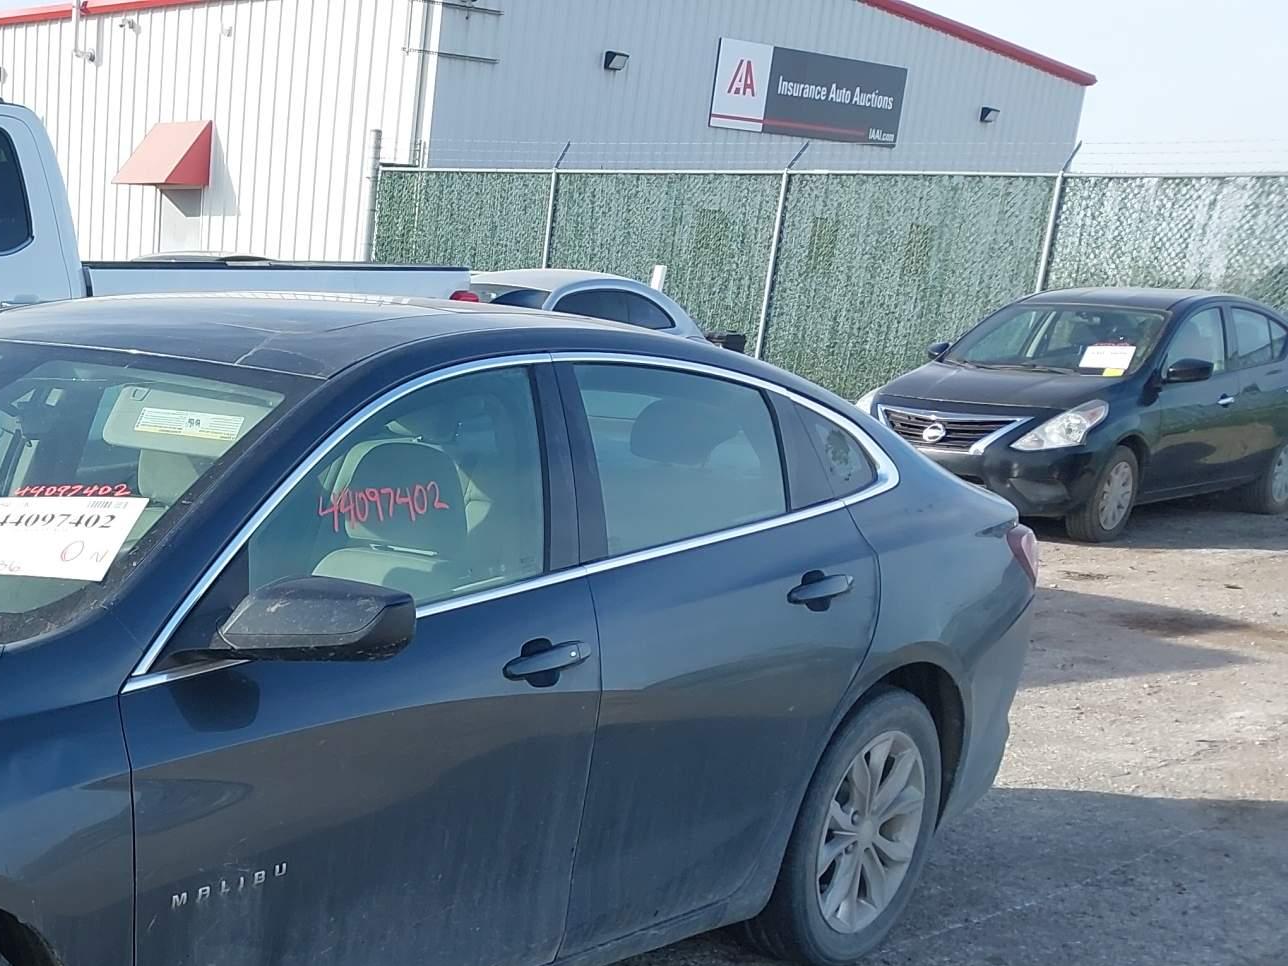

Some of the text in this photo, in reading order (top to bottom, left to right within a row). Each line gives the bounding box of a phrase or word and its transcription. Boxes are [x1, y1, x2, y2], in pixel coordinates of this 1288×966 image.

[777, 75, 894, 110] Insurance Auto Auctions
[868, 127, 895, 142] IAAI.com
[14, 483, 131, 497] 44097402
[318, 480, 450, 533] 44097402
[172, 862, 288, 909] MALIBU
